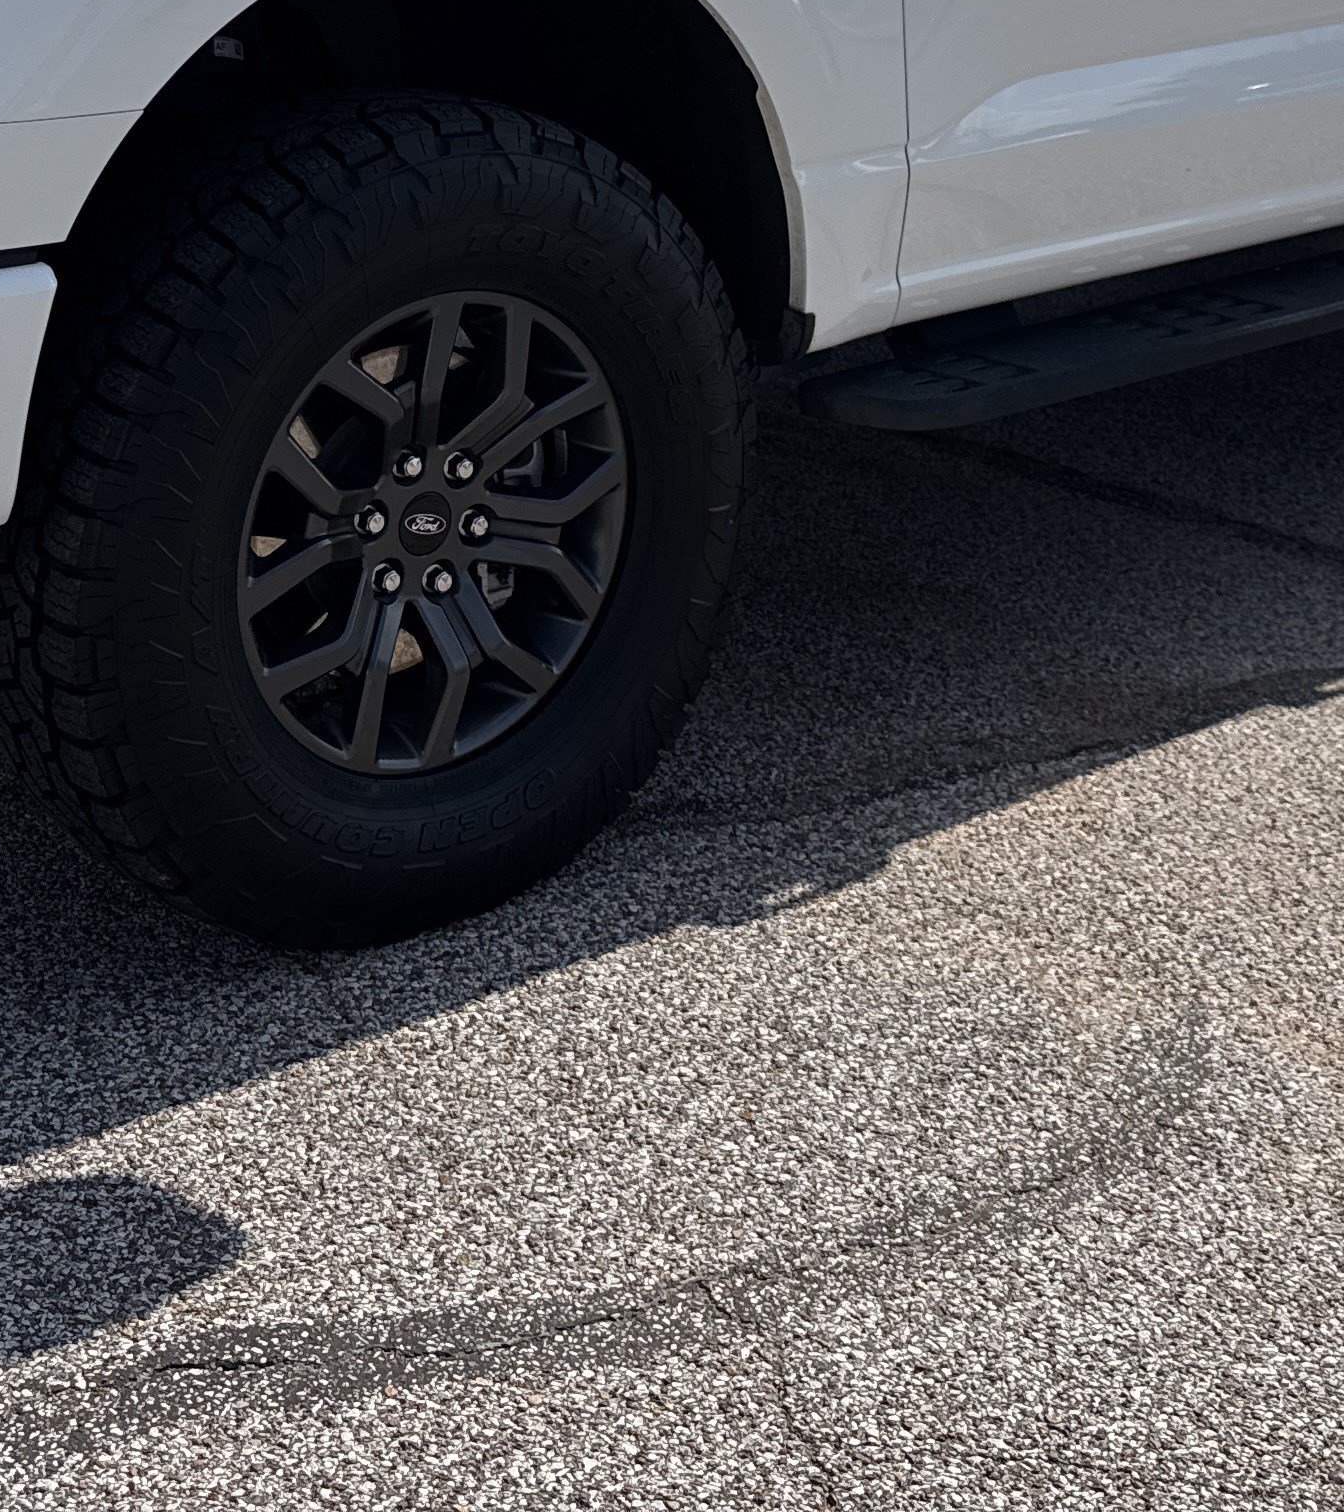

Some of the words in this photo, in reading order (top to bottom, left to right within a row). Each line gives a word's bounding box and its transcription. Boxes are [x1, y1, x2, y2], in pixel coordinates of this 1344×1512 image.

[466, 221, 606, 280] TOYO
[412, 516, 440, 531] Ford
[207, 703, 404, 856] COUNTRY
[417, 763, 556, 856] OPEN
